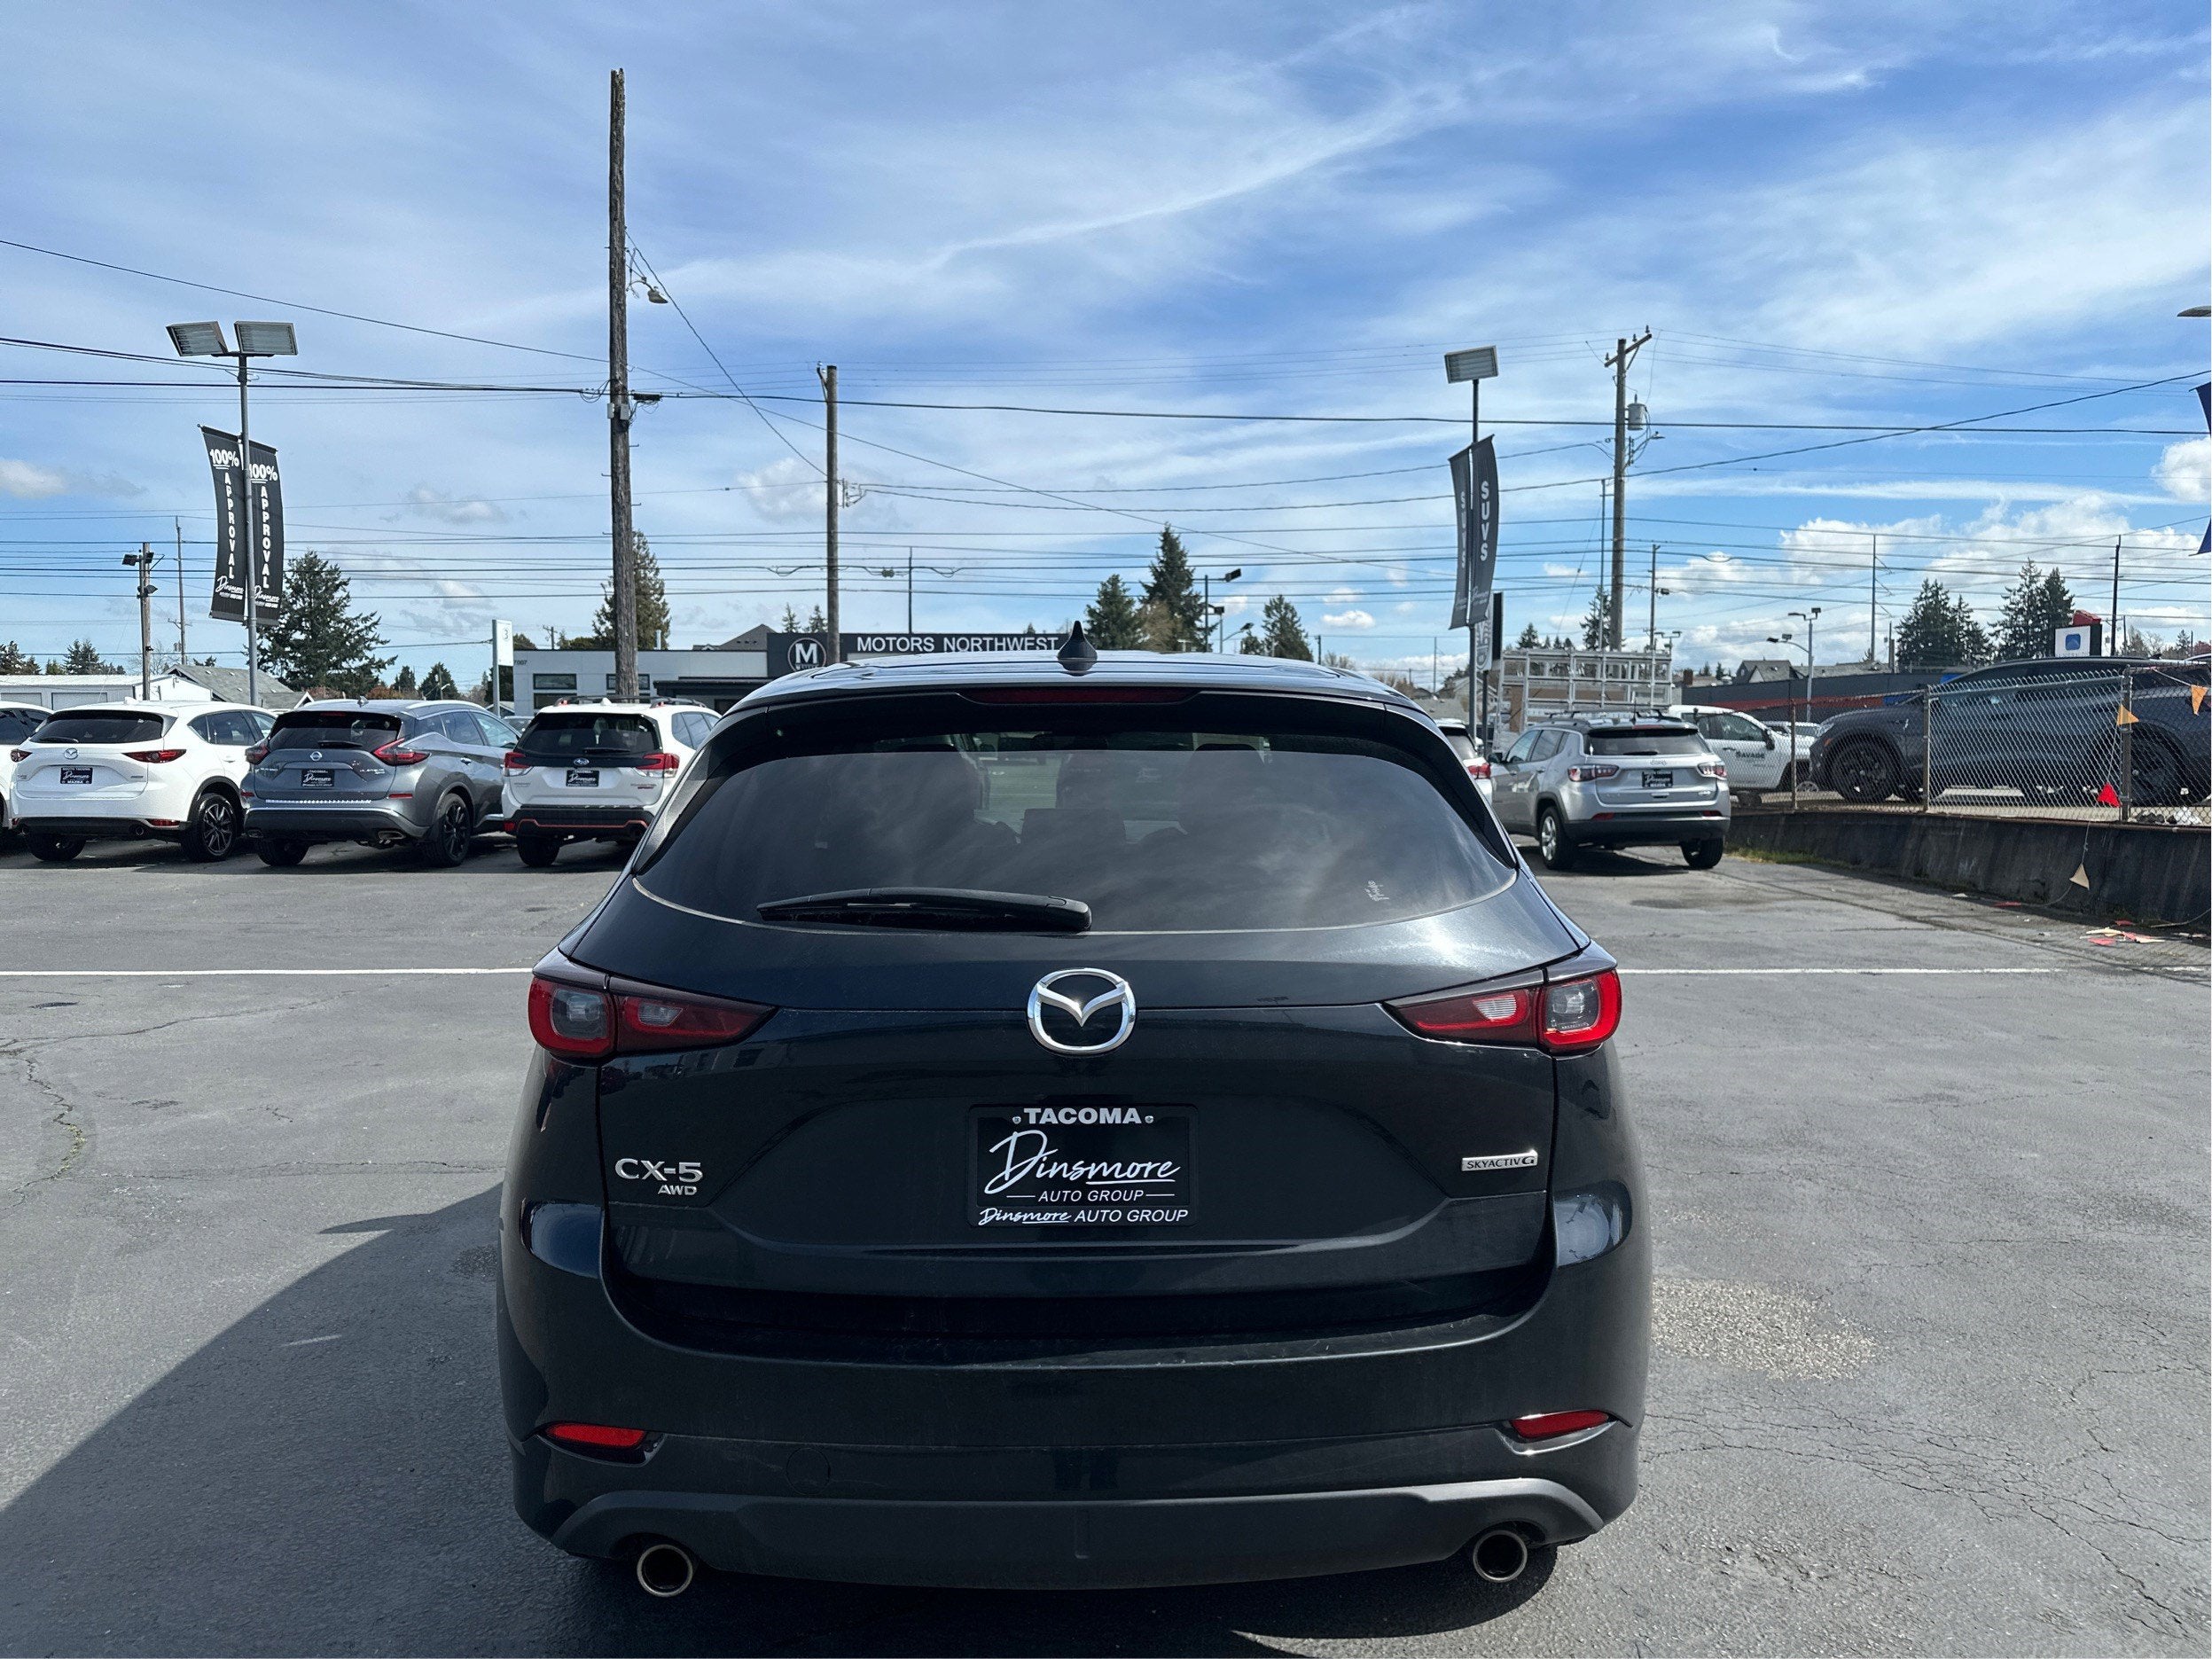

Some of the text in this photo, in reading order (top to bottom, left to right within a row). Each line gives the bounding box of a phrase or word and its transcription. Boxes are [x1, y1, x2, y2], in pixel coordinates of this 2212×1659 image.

[209, 449, 239, 467] 100%
[224, 473, 235, 580] APPROVAL
[1480, 480, 1489, 561] SUVS
[260, 486, 270, 589] APPROVAL
[795, 643, 817, 664] M
[856, 636, 1059, 653] MOTORS NORTHWEST
[1023, 1107, 1142, 1124] TACOMA
[614, 1158, 703, 1183] CX-5
[984, 1130, 1181, 1194] Dinsmore
[658, 1185, 698, 1196] AWD
[1037, 1190, 1144, 1201] AUTO GROUP
[978, 1208, 1188, 1226] Dinsmore AUTO GROUP
